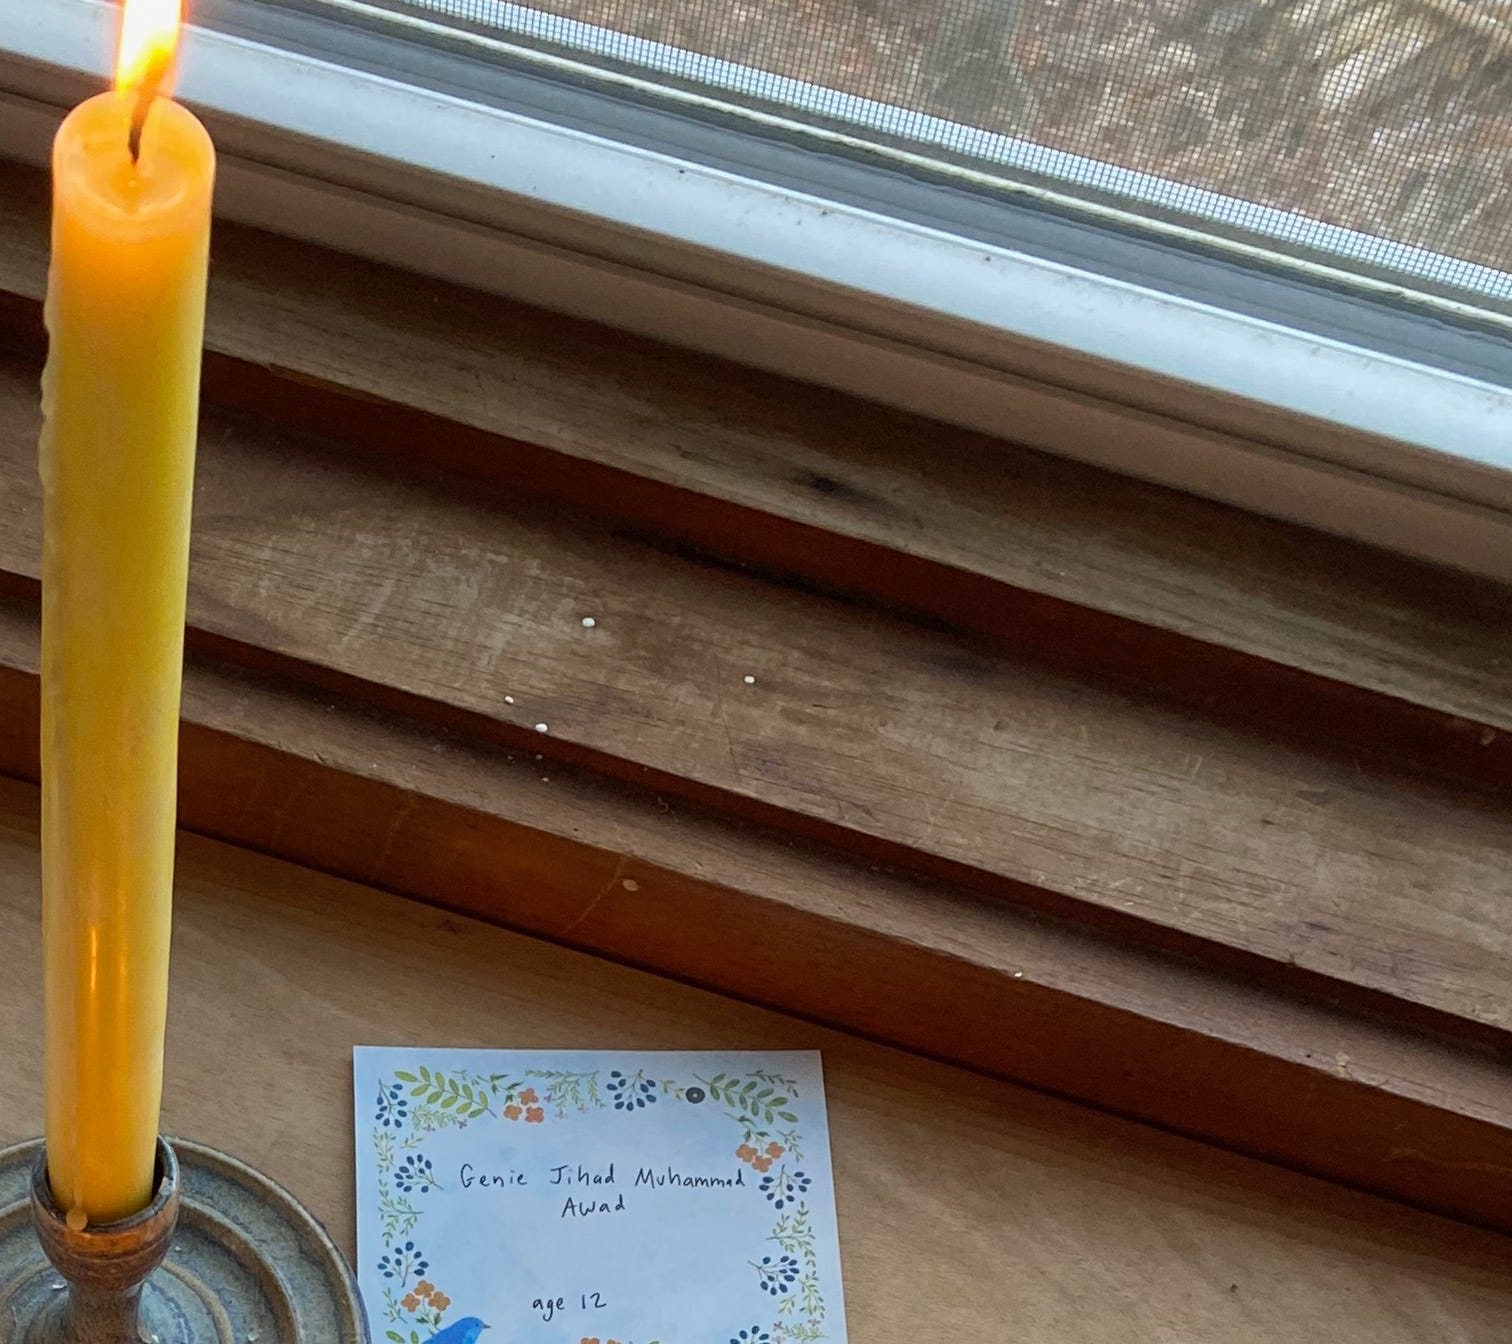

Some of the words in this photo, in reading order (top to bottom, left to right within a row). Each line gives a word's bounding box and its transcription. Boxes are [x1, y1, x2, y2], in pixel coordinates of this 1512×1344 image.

[460, 1163, 528, 1189] Genie
[549, 1162, 615, 1187] Jihad
[634, 1166, 746, 1189] Muhammad
[560, 1193, 626, 1219] Awad
[532, 1297, 565, 1322] age
[581, 1292, 608, 1310] 12
